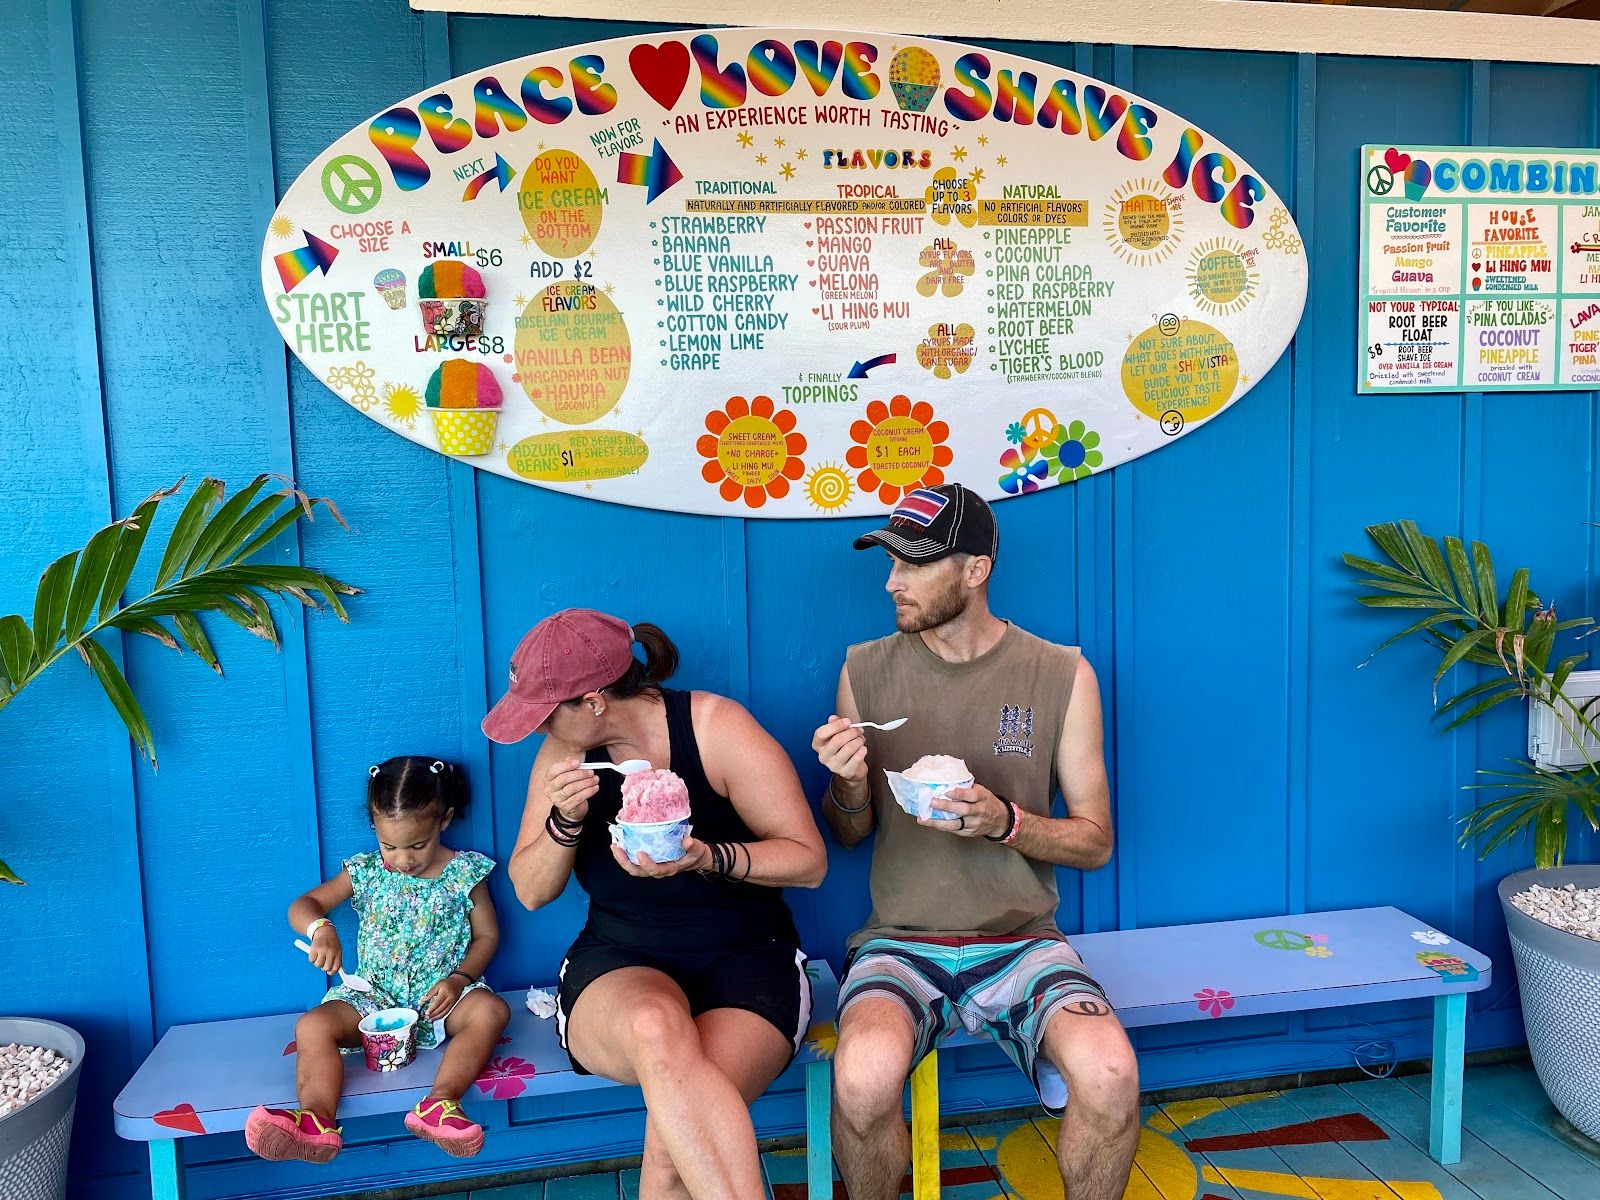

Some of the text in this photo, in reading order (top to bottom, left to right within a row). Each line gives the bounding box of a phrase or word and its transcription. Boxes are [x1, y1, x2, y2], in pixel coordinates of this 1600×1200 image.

[706, 106, 807, 130] EXPERIENCE
[815, 105, 870, 127] WORTH
[368, 33, 1267, 230] PEACE LOVE SHAVE ICE
[590, 118, 641, 147] NOW FOR
[597, 132, 644, 159] FLAVORS
[535, 156, 579, 171] DO YOU
[823, 148, 932, 169] FLAVORS
[453, 158, 485, 182] NEXT
[541, 171, 576, 184] WANT
[1433, 158, 1600, 195] COMBIN
[695, 180, 777, 195] TRADITIONAL
[837, 184, 900, 199] TROPICAL
[932, 178, 968, 190] CHOOSE
[1003, 184, 1062, 199] NATURAL
[517, 187, 609, 211] ICE CREAM
[687, 200, 925, 212] NATURALLY AND ARTIFICIALLY FLAVORED AND/OR COLORED
[984, 202, 1082, 213] NO ARTIFICIAL FLAVORS
[1119, 199, 1167, 212] THAI TEA
[540, 209, 584, 223] ON THE
[932, 203, 973, 214] FLAVORS
[1386, 206, 1447, 219] Customer
[1489, 208, 1536, 226] HOUSE
[330, 220, 411, 240] CHOOSE A
[536, 224, 591, 239] BOTTOM
[661, 216, 767, 234] STRAWBERRY
[816, 217, 925, 235] PASSION FRUIT
[1386, 219, 1447, 233] Favorite
[995, 228, 1072, 246] PINEAPPLE
[1484, 227, 1540, 242] FAVORITE
[358, 236, 390, 253] SIZE
[662, 236, 731, 253] BANANA
[818, 236, 872, 253] MANGO
[933, 237, 953, 250] ALL
[1485, 244, 1548, 259] PINEAPPLE
[422, 241, 503, 269] SMALL $6
[663, 254, 774, 272] BLUE VANILLA
[919, 251, 941, 259] SYRUP
[995, 246, 1062, 263] COCONUT
[1200, 254, 1241, 272] COFFEE
[1394, 256, 1433, 269] Mango
[530, 259, 592, 281] ADD $2
[818, 255, 870, 272] GUAVA
[996, 264, 1092, 282] PINA COLADA
[1391, 269, 1434, 283] Guava
[546, 285, 596, 296] ICE CREAM
[664, 274, 799, 292] BLUE RASPBERRY
[819, 273, 879, 291] MELONA
[996, 281, 1115, 301] RED RASPBERRY
[276, 291, 365, 323] START
[542, 295, 596, 312] FLAVORS
[666, 294, 775, 312] WILD CHERRY
[821, 302, 910, 321] LI HING MUI
[997, 300, 1092, 319] WATERMELON
[1484, 300, 1535, 312] IF YOU LIKE
[667, 313, 789, 332] COTTON CANDY
[828, 321, 870, 331] (SOUR PLUM)
[1388, 315, 1448, 329] ROOT BEER
[1474, 311, 1547, 327] PINA COLADAS
[539, 328, 607, 342] ICE CREAM
[937, 323, 956, 336] ALL
[998, 318, 1074, 338] ROOT BEER
[1402, 328, 1433, 341] FLOAT
[295, 321, 371, 354] HERE
[414, 334, 504, 356] LARGE $8
[669, 333, 765, 352] LEMON LIME
[922, 336, 974, 347] SYRUPS MADE
[1138, 333, 1216, 351] NOT SURE ABOUT
[1479, 329, 1541, 347] COCONUT
[999, 338, 1050, 356] LYCHEE
[515, 346, 631, 367] VANILLA BEAN
[670, 353, 720, 370] GRAPE
[999, 351, 1104, 375] TIGER'S BLOOD
[1479, 348, 1539, 364] PINEAPPLE
[1572, 354, 1597, 365] PINA
[1130, 365, 1146, 377] LET
[1149, 363, 1168, 374] OUR
[1378, 361, 1453, 370] OVER VANILLA ICE CREAM
[524, 367, 629, 384] MACADAMIA NUT
[808, 372, 843, 383] FINALLY
[1143, 370, 1219, 389] GUIDE YOU TO A
[1477, 371, 1541, 382] COCONUT CREAM
[545, 382, 607, 401] HAUPIA
[781, 384, 859, 405] TOPPINGS
[1144, 382, 1222, 402] DELICIOUS TASTE
[728, 432, 777, 441] SWEET CREAM
[512, 443, 561, 458] ADZUKI
[561, 450, 574, 467] $1
[898, 446, 921, 457] EACH
[516, 458, 559, 472] BEANS
